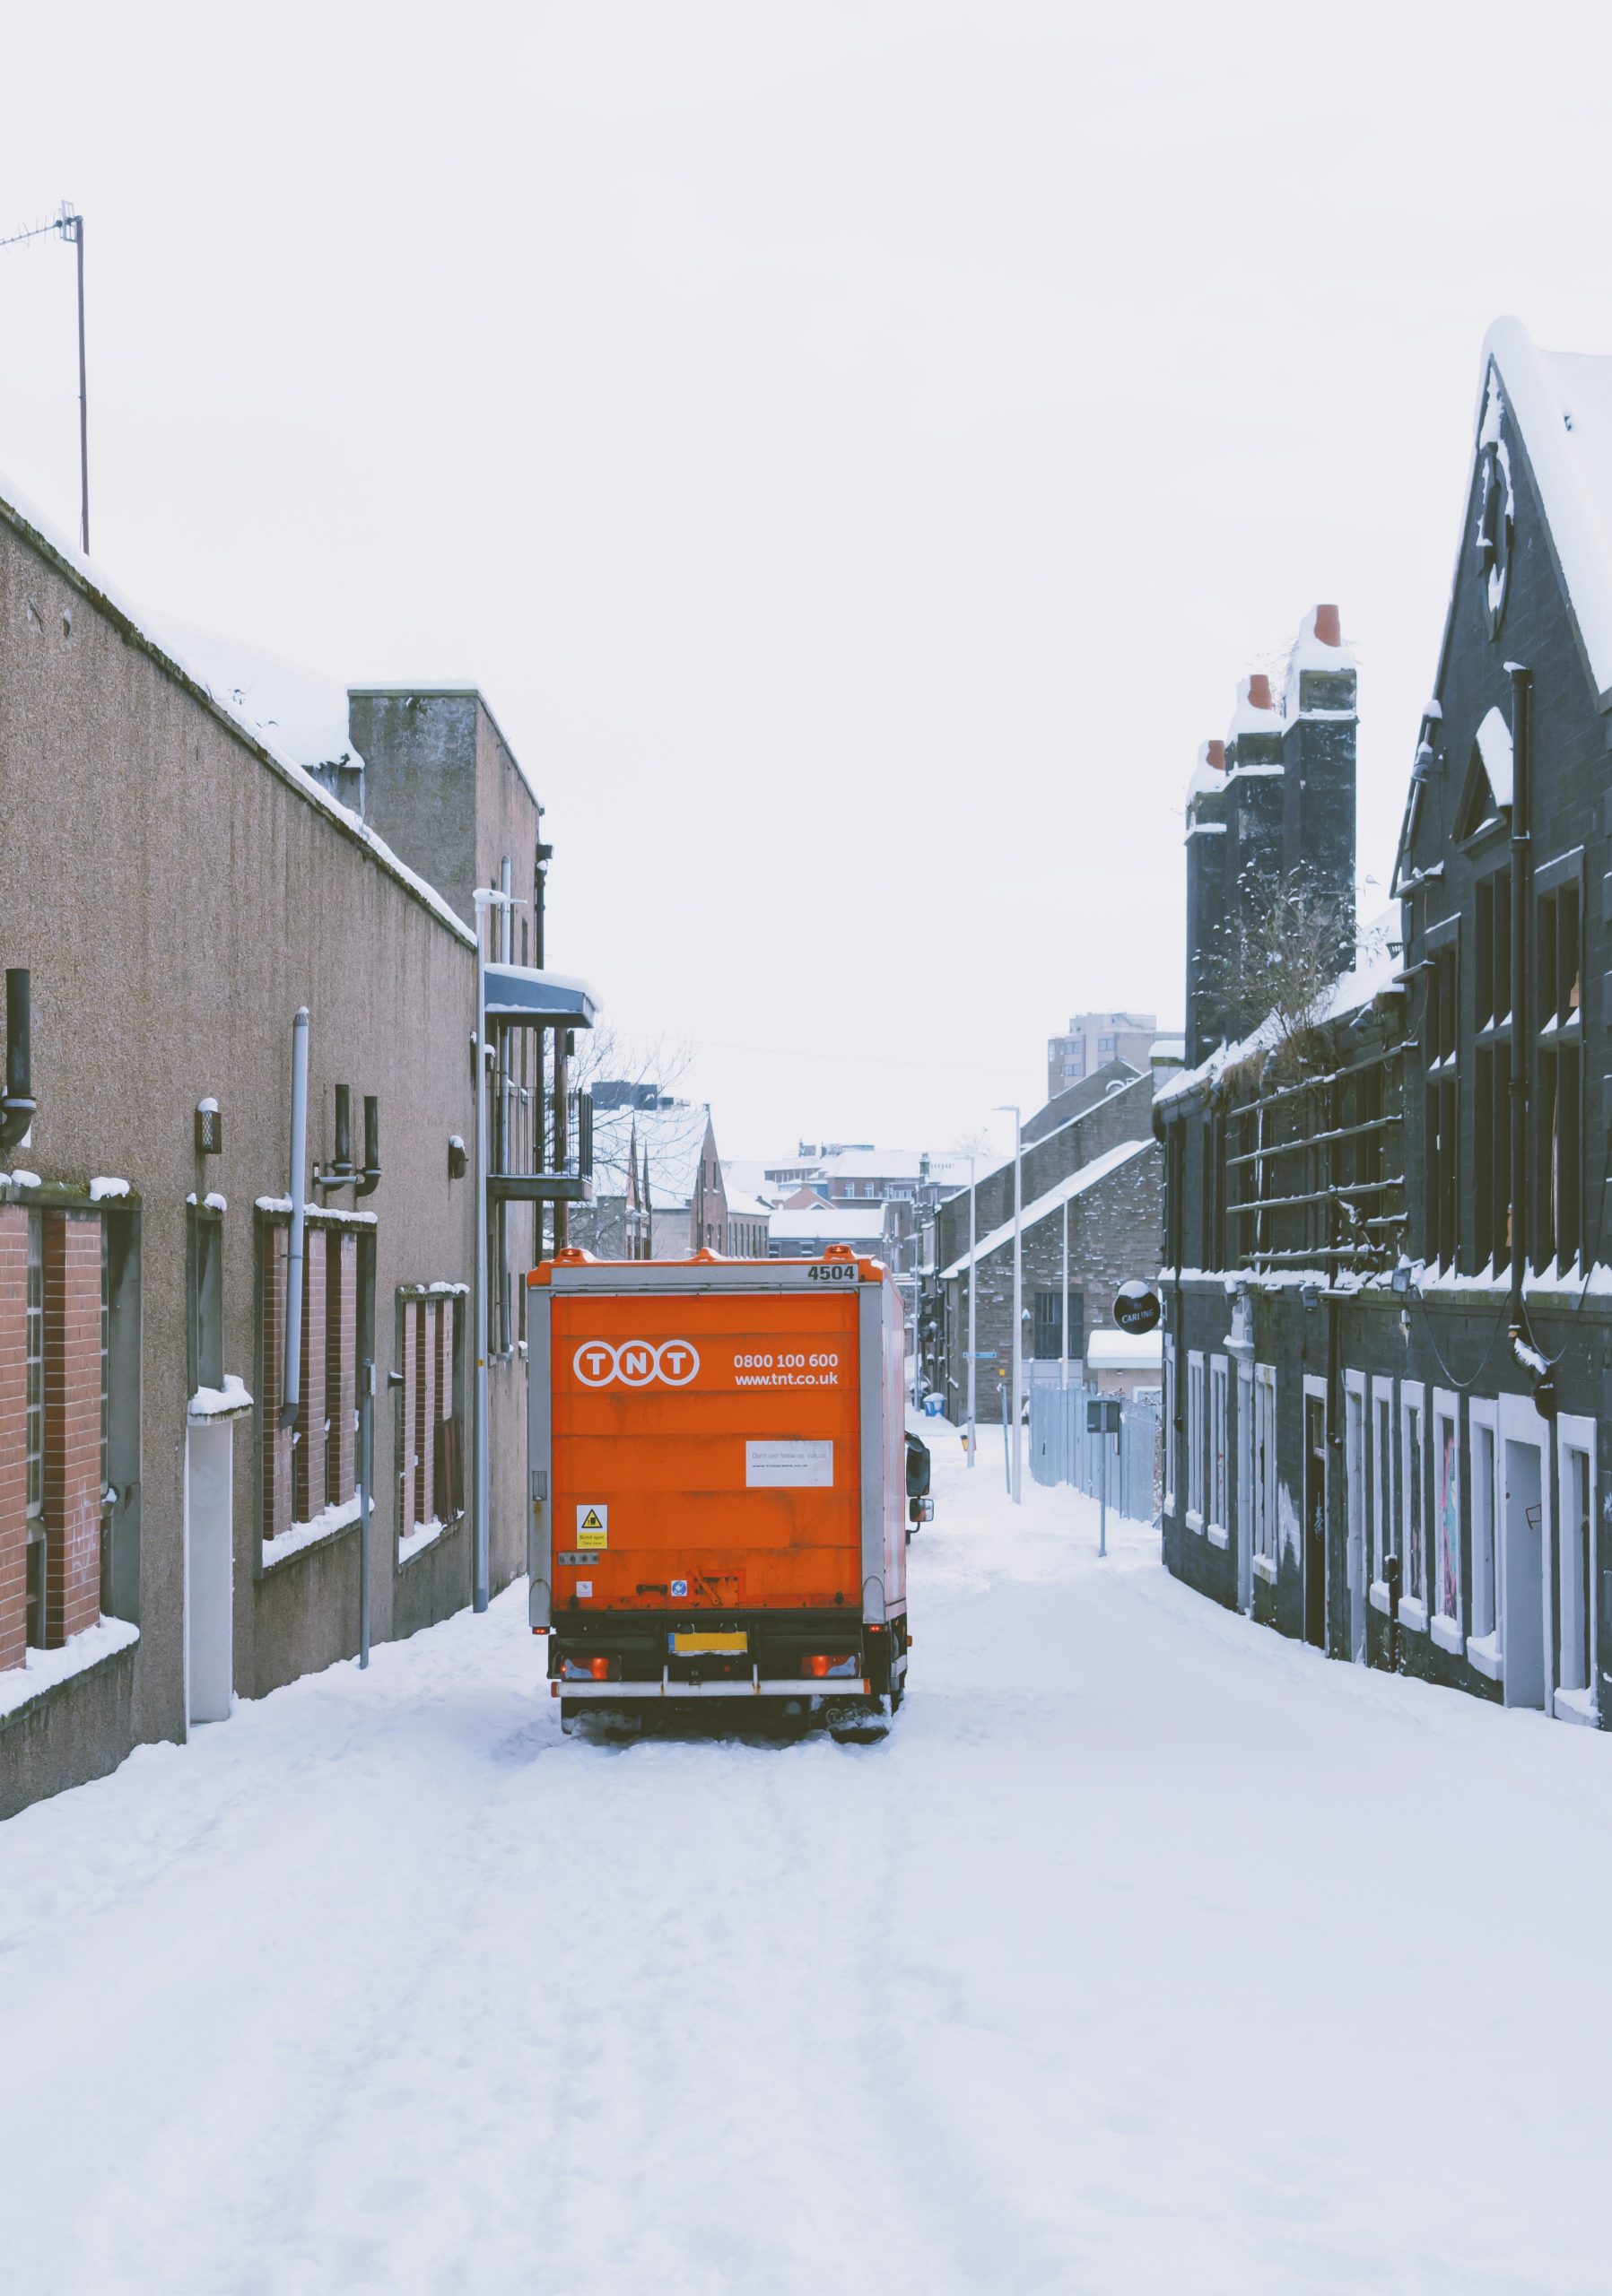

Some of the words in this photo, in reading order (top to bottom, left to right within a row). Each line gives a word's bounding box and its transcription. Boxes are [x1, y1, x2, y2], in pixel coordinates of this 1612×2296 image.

[807, 1265, 854, 1281] 4504
[1121, 1309, 1155, 1324] CARLING
[733, 1354, 773, 1368] 0800
[777, 1353, 805, 1368] 100
[808, 1353, 839, 1368] 600
[735, 1371, 839, 1386] www.tnt.co.uk
